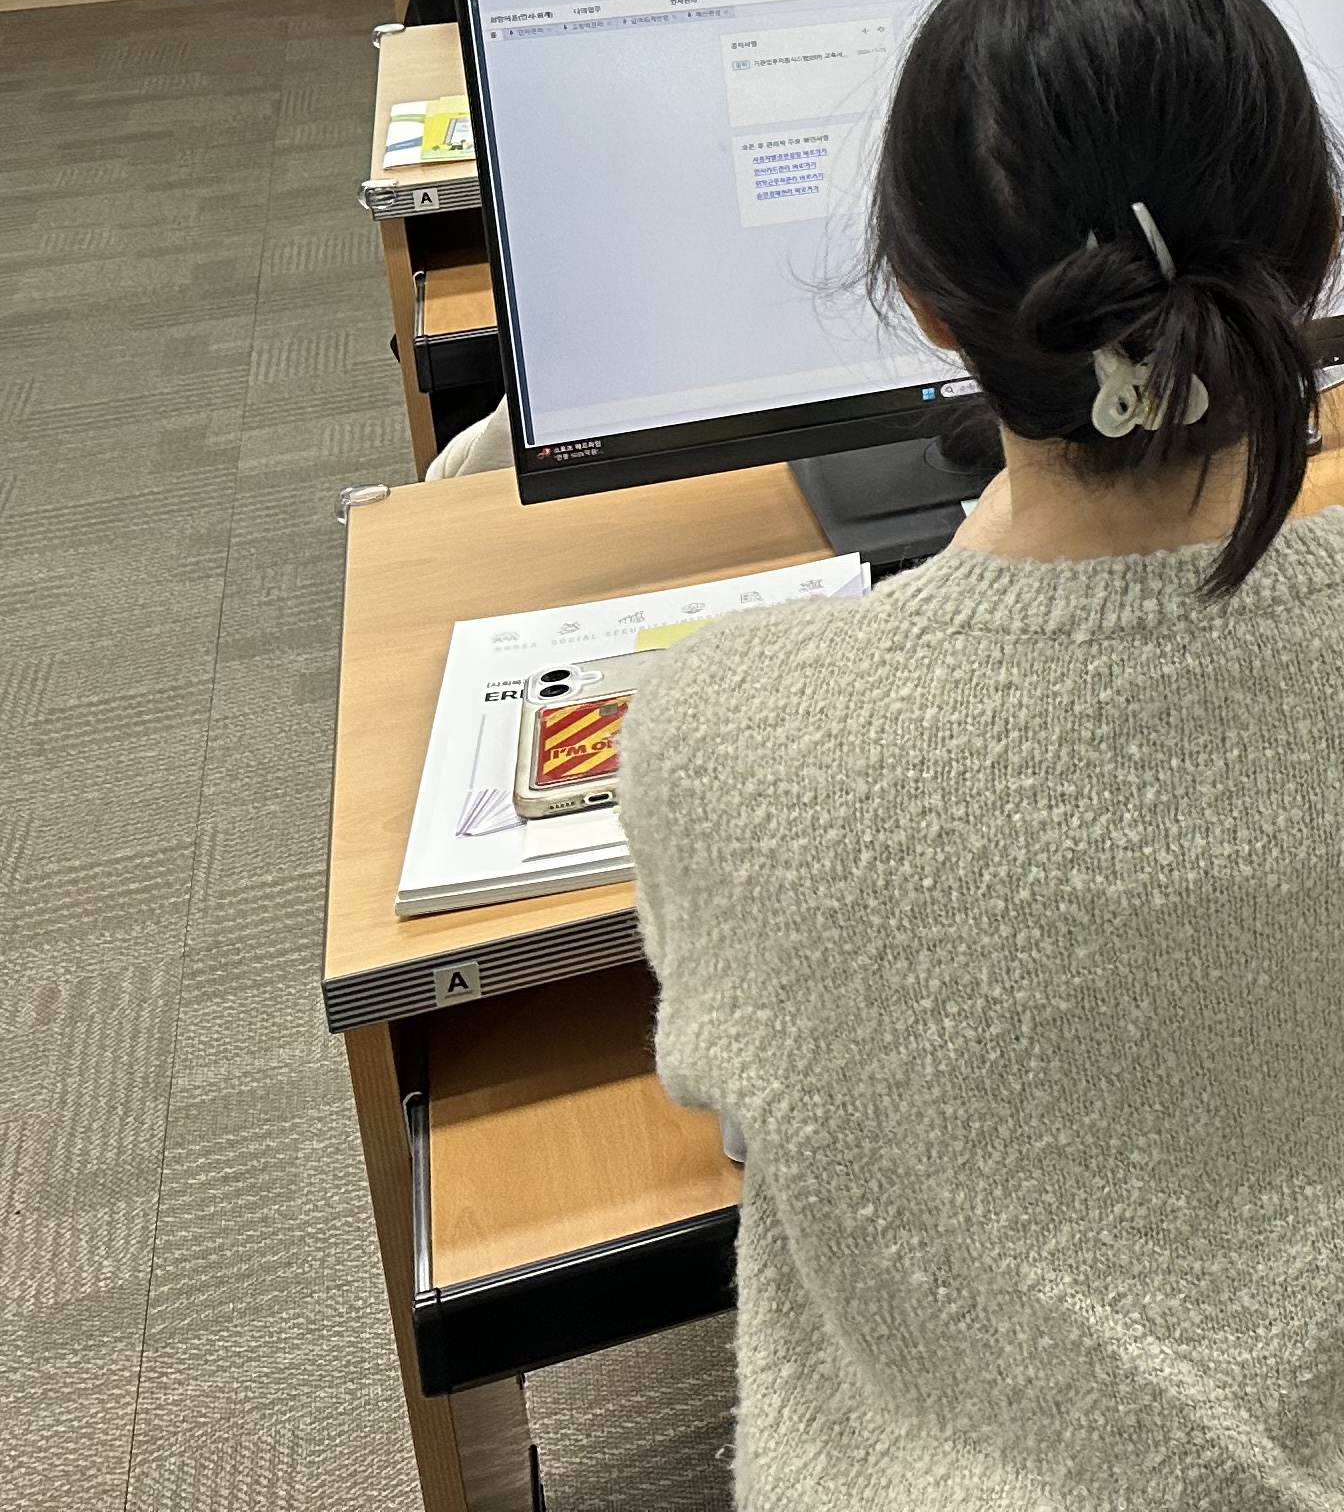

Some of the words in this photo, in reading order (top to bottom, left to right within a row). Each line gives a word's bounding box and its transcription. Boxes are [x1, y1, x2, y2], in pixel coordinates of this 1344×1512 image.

[420, 191, 433, 205] A
[494, 642, 537, 653] KOREA
[551, 633, 597, 646] SOCIAL
[447, 971, 469, 993] A
